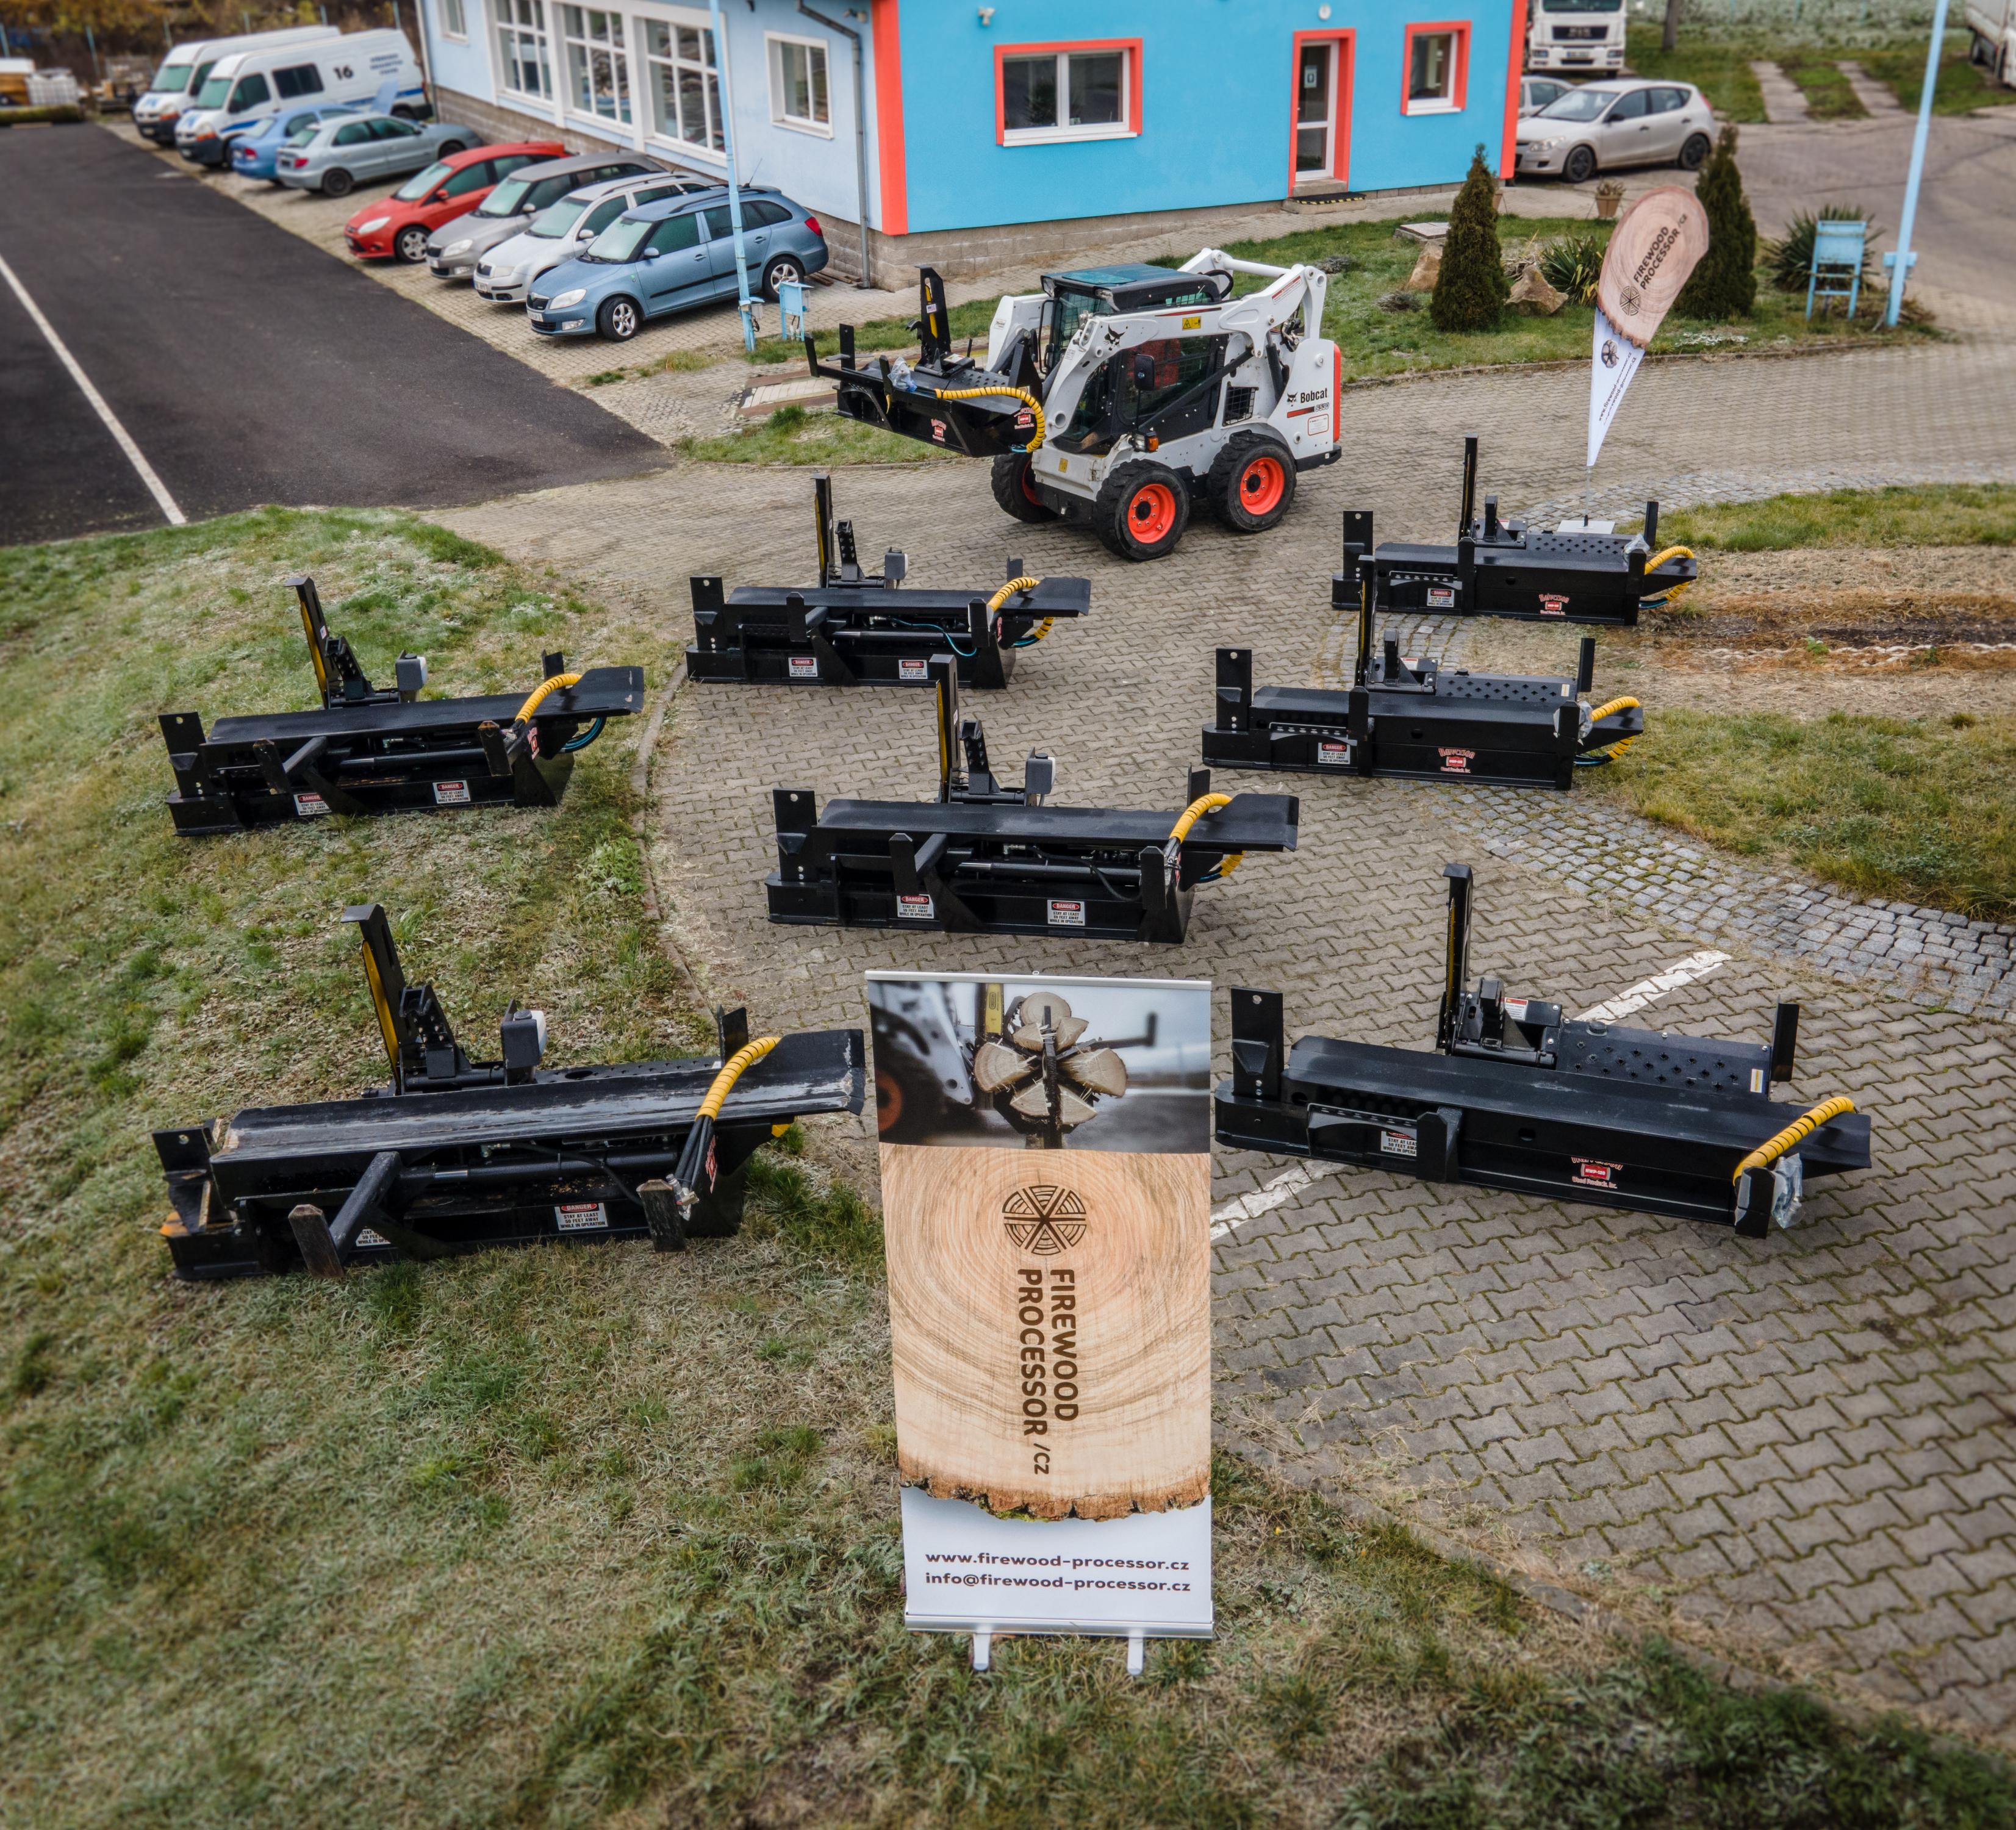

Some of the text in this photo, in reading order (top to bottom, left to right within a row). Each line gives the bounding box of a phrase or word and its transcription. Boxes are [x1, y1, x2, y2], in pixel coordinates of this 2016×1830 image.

[333, 65, 354, 81] 16
[1633, 226, 1670, 283] FIREWOOD
[1640, 228, 1680, 290] PROCESSOR
[1300, 387, 1328, 403] Bobcat
[1017, 1269, 1048, 1436] PROCESSOR
[1050, 1269, 1079, 1421] FIREWOOD
[925, 1552, 1189, 1571] www.firewood-processor.cz
[925, 1572, 1191, 1591] info@firewood-processor.cz
